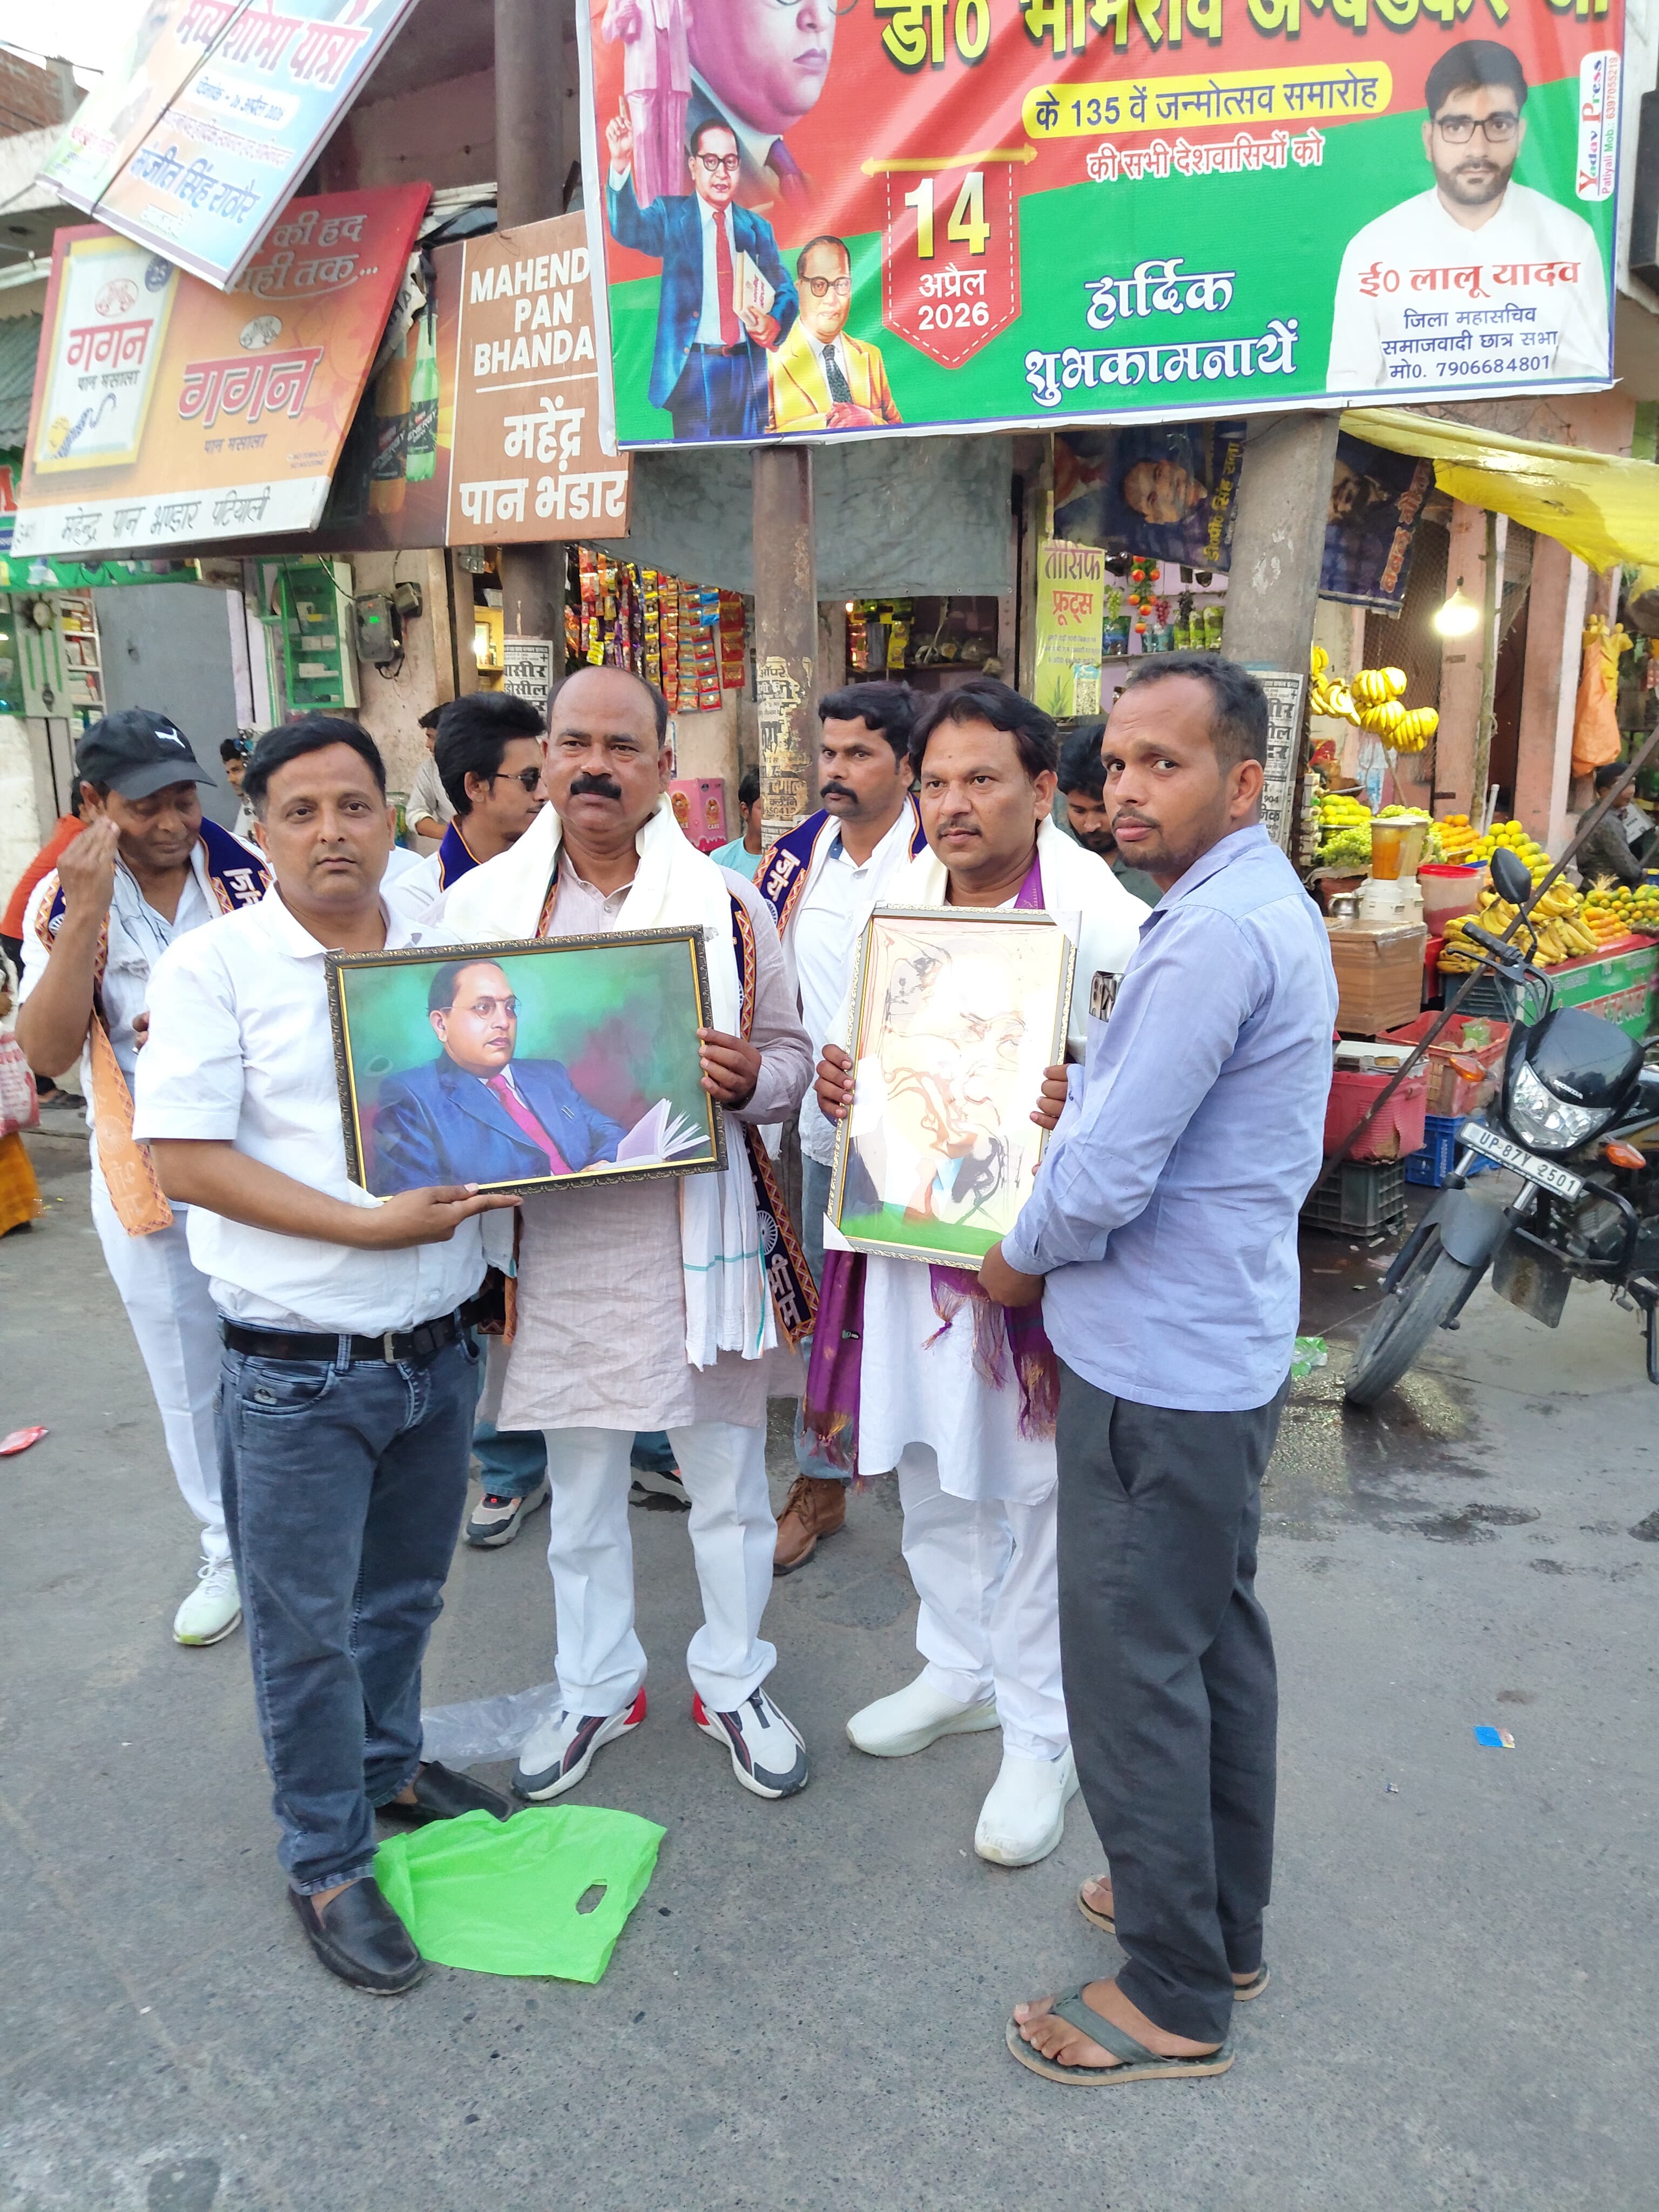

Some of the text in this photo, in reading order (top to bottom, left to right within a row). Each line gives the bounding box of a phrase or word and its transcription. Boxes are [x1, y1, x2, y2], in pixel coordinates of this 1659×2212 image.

[1036, 69, 1379, 131] के 135 वें जन्मोत्सव समारोह
[1606, 56, 1618, 120] 6397055219
[1579, 59, 1602, 193] Yadav Press
[1088, 127, 1325, 182] की सभी देशवासियों को
[1602, 155, 1615, 195] Patiyali
[273, 210, 368, 246] की हद
[904, 171, 991, 259] 14
[919, 263, 986, 299] अप्रैल
[1084, 258, 1236, 330] हार्दिक
[1410, 265, 1491, 299] लालू
[1492, 261, 1581, 287] यादव
[514, 289, 574, 333] PAN
[919, 301, 990, 331] 2026
[1404, 302, 1537, 329] जिला महासचिव
[67, 319, 154, 373] गगन
[1382, 329, 1558, 355] समाजवादी छात्र सभा
[77, 368, 142, 392] पान मसाला
[1024, 318, 1300, 408] शुभकामनायें
[1436, 354, 1550, 377] 7906684801
[178, 346, 325, 428] गगन
[204, 433, 268, 454] पान मसाला
[460, 460, 629, 525] पान भंडार
[113, 506, 146, 538] पान
[1553, 1079, 1583, 1100] HONDA
[1537, 1164, 1576, 1192] 2501
